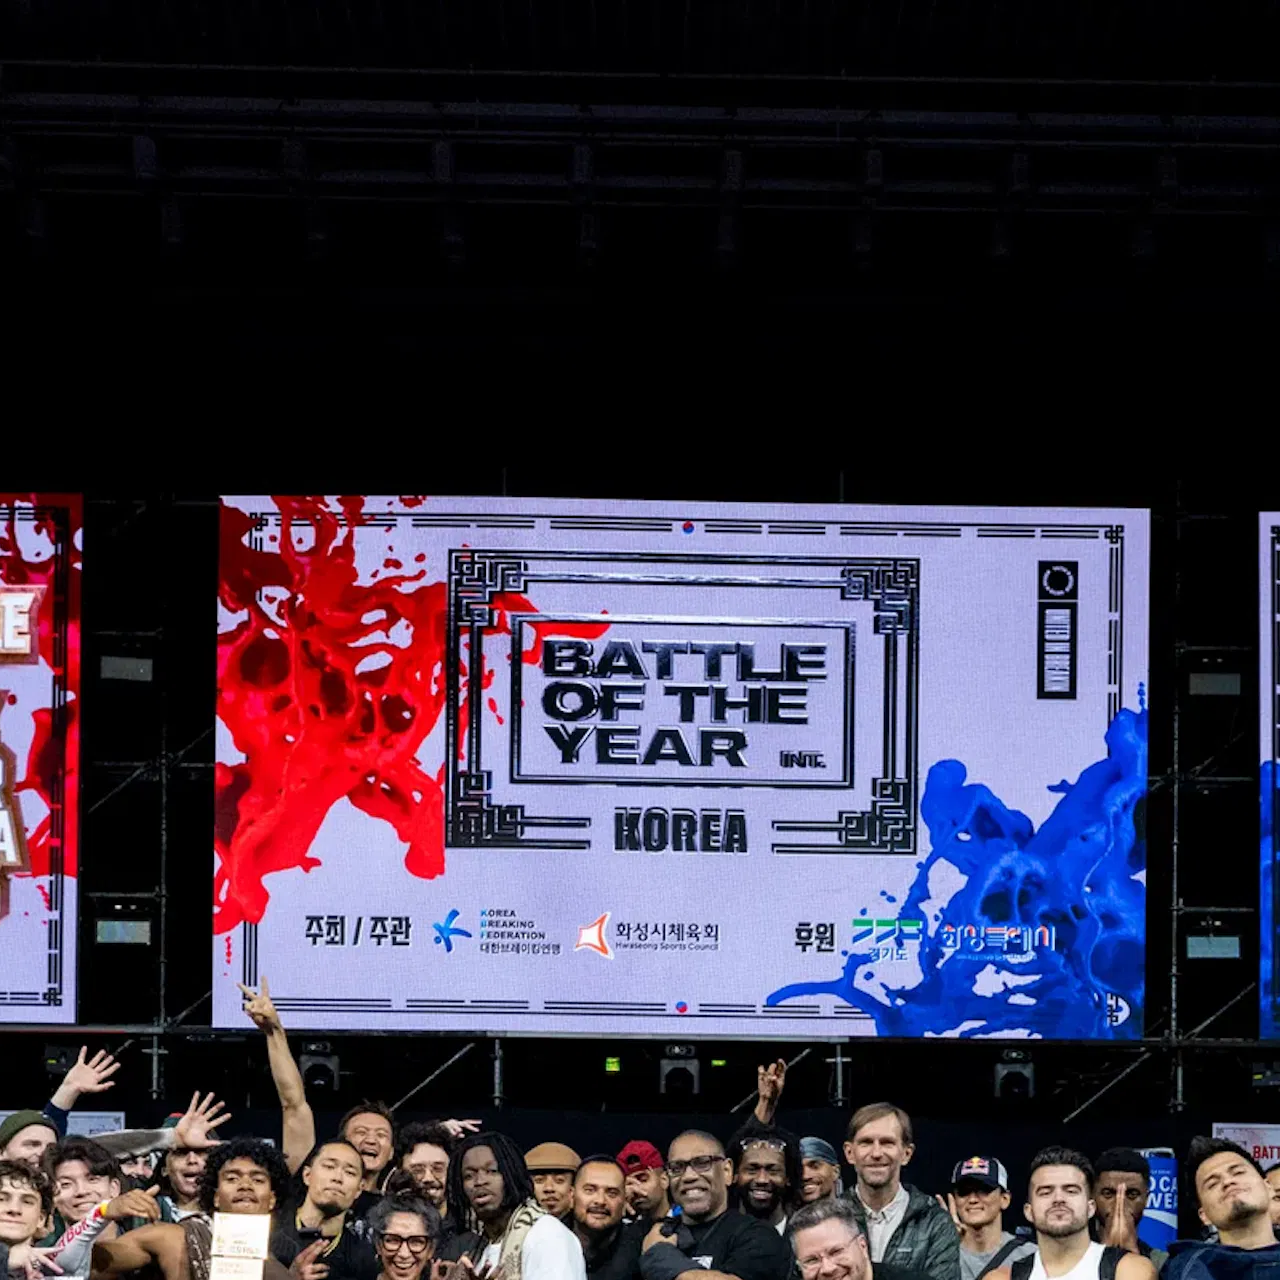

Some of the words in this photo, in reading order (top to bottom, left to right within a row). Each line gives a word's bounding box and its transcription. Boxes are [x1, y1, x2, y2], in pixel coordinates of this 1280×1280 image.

[542, 640, 827, 682] BATTLE
[541, 682, 646, 722] OF
[664, 684, 809, 725] THE
[542, 725, 749, 768] YEAR
[780, 750, 827, 769] INT.
[614, 807, 748, 853] KOREA
[480, 909, 517, 917] KOREA
[480, 920, 535, 929] BREAKING
[305, 914, 346, 946] 주최
[370, 915, 412, 947] 주관
[480, 931, 546, 940] FEDERATION
[615, 921, 720, 943] 화성시체육회
[795, 922, 836, 953] 후원
[615, 941, 659, 952] Hwaseong
[660, 942, 686, 952] Sports
[687, 941, 720, 952] Council
[869, 947, 909, 962] 경기도
